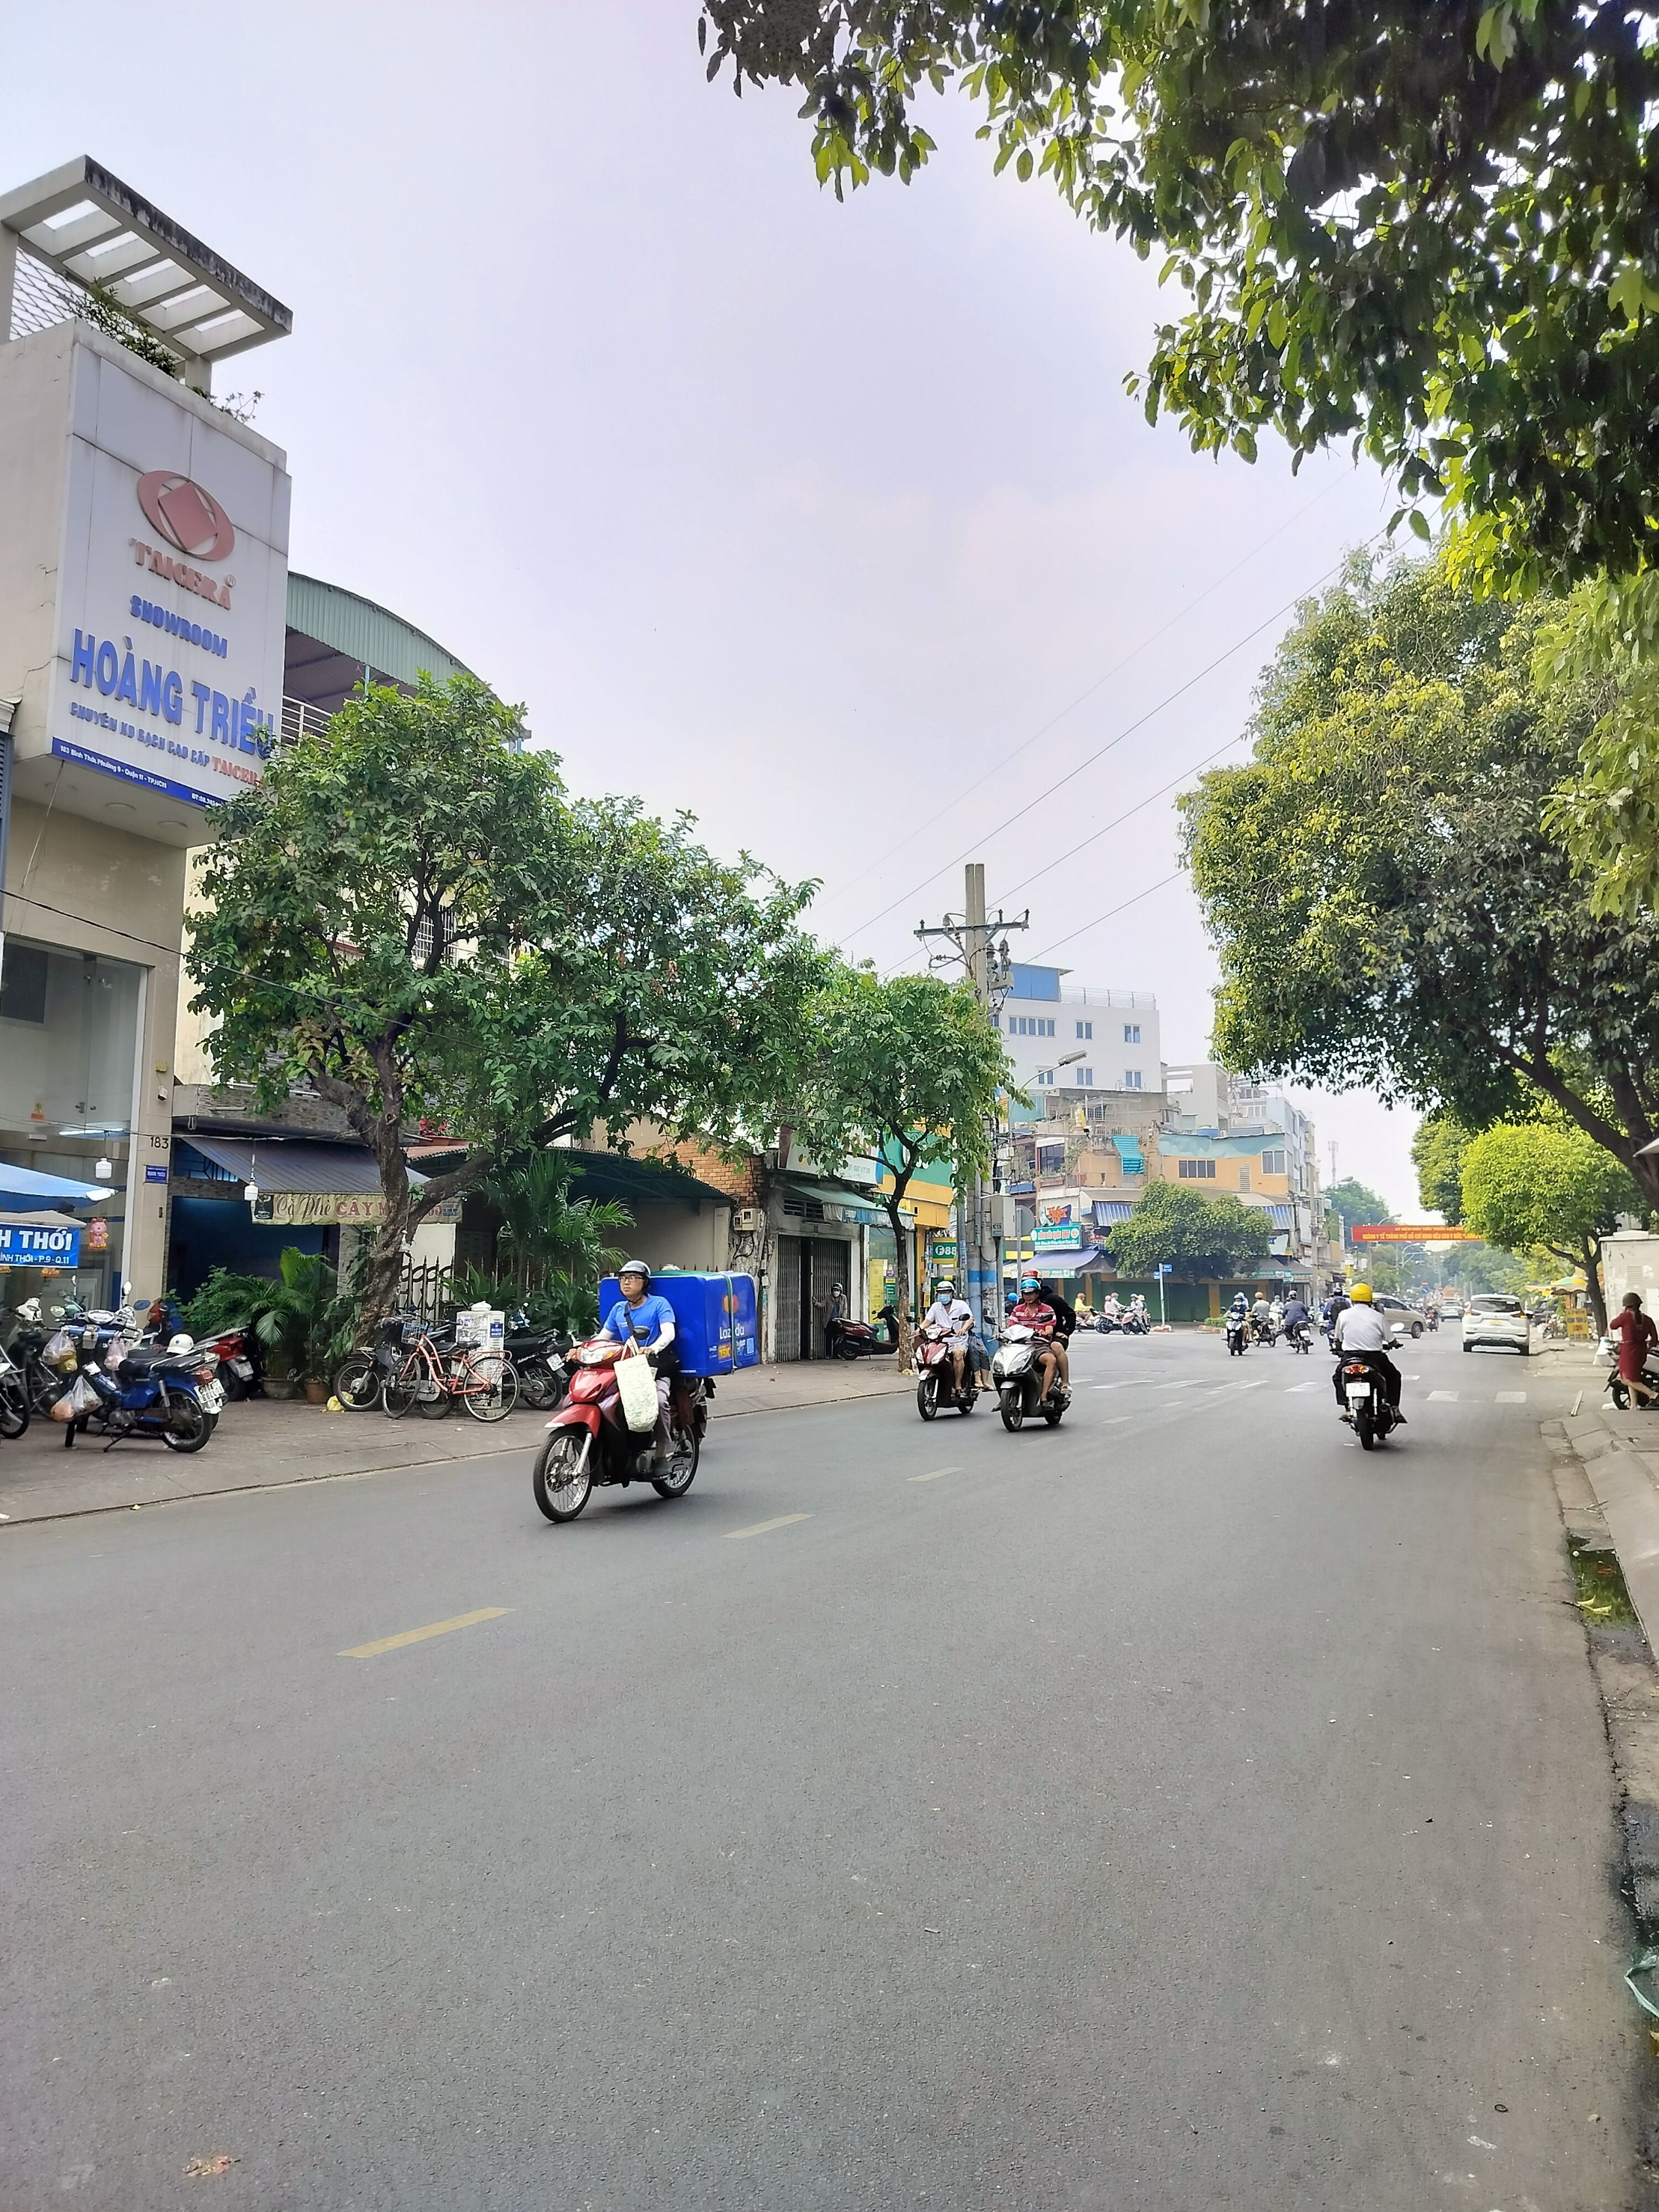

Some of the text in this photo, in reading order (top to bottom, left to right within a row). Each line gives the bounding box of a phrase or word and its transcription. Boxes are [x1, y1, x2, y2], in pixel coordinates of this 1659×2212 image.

[129, 537, 231, 611] TAICERA
[129, 594, 227, 659] SHOWROOM
[70, 627, 275, 760] HOÀNG TRIỀU
[61, 745, 70, 754] 183
[71, 749, 83, 759] Bình
[120, 721, 135, 739] KD
[168, 741, 189, 759] CAO
[191, 749, 210, 767] CẤP
[150, 1135, 169, 1149] 183
[277, 1194, 294, 1216] Cà
[337, 1198, 376, 1217] CÂY
[1047, 1205, 1068, 1223] Tiger
[19, 1228, 73, 1250] THỚI
[39, 1255, 51, 1263] P.9
[55, 1256, 70, 1264] Q.11
[719, 1323, 745, 1339] Lazda
